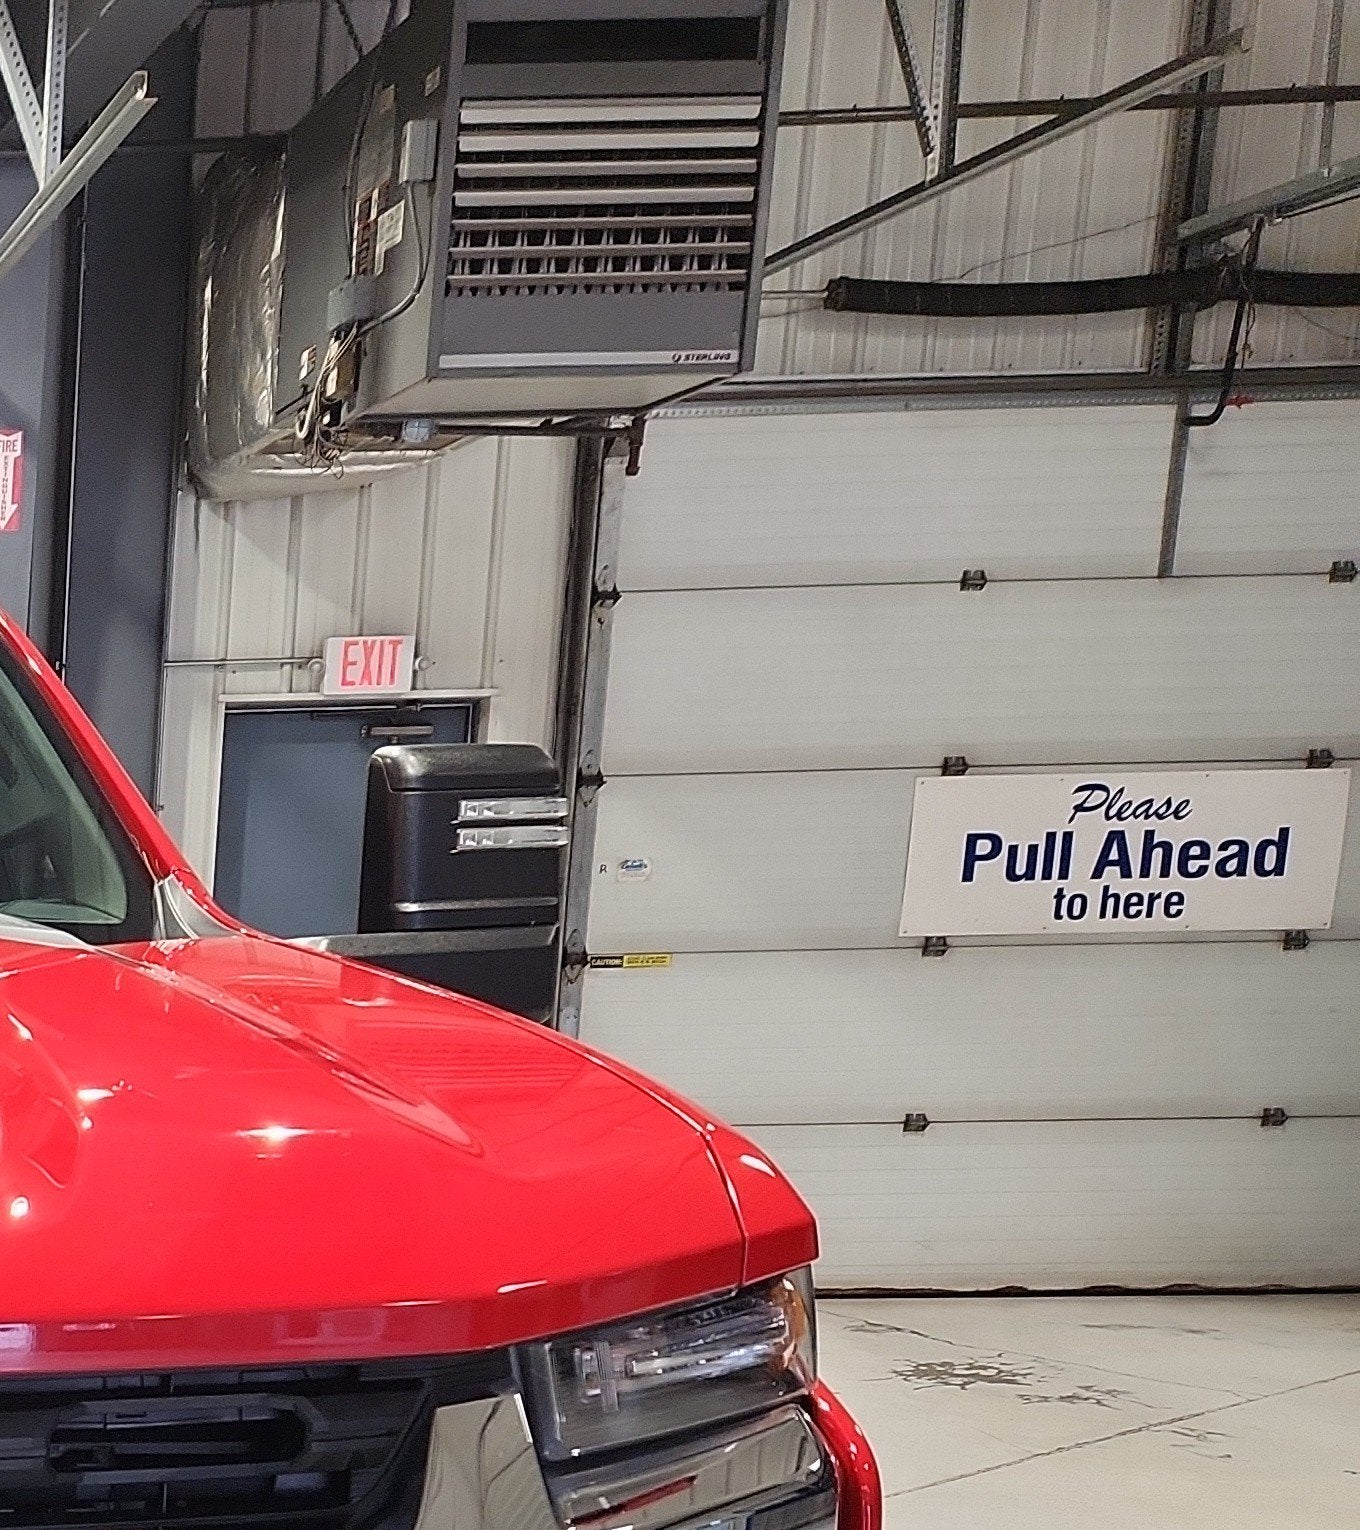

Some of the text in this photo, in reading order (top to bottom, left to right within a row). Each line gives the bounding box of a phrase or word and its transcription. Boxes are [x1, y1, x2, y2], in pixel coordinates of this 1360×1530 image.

[0, 455, 9, 522] EXTINGUISHER
[340, 639, 404, 687] EXIT
[1067, 783, 1193, 825] Please
[961, 826, 1292, 883] Pull Ahead
[1052, 885, 1185, 921] to here
